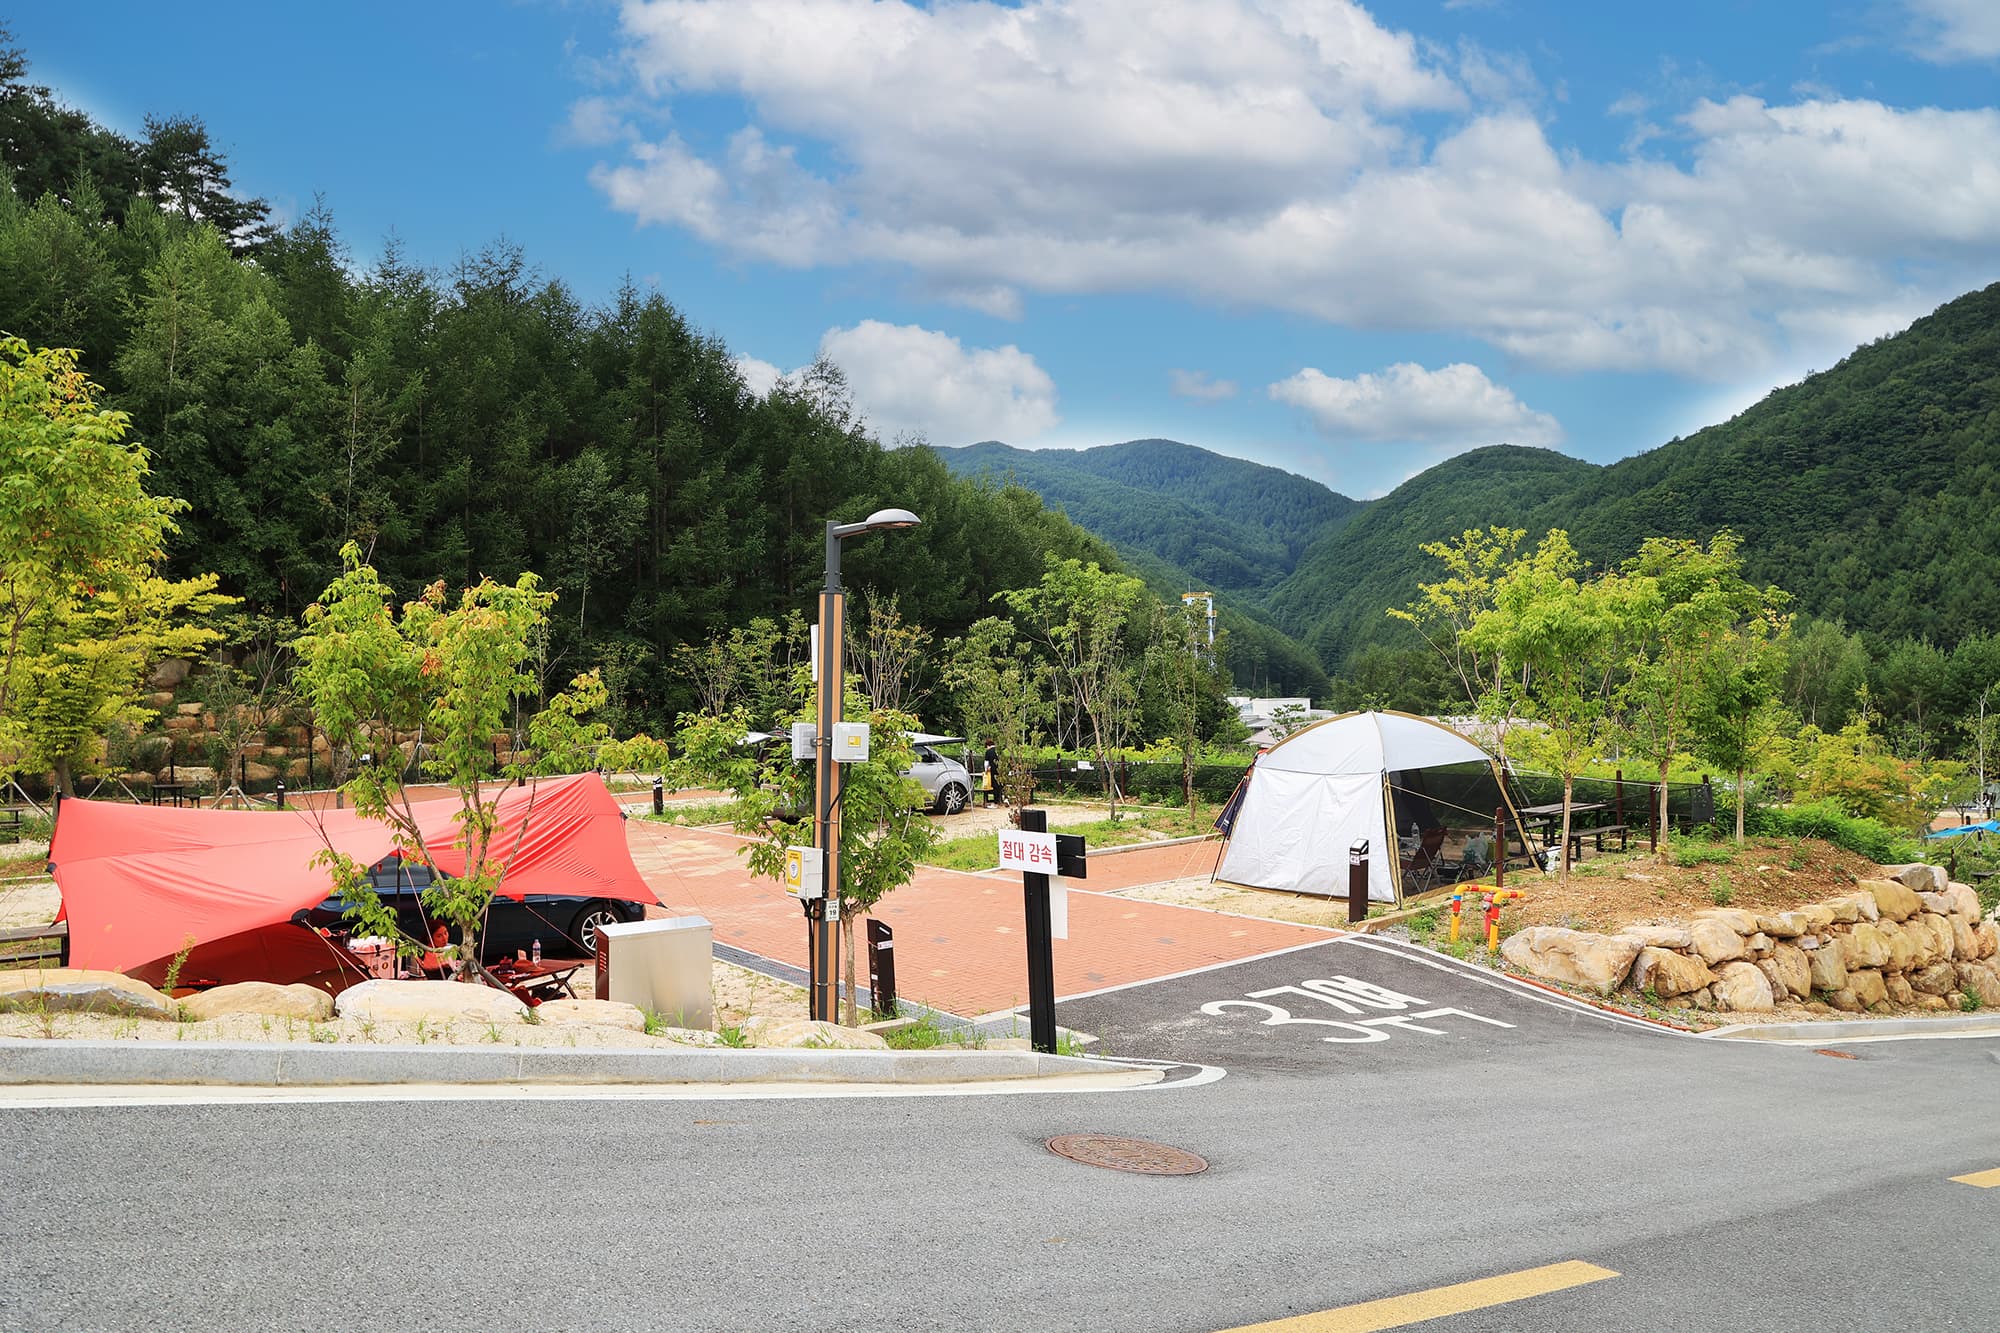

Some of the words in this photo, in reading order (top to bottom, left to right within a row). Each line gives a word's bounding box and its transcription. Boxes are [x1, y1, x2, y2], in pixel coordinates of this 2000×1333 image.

[1002, 840, 1025, 861] 절대
[1029, 843, 1052, 865] 감속
[1200, 974, 1517, 1043] 3구역
